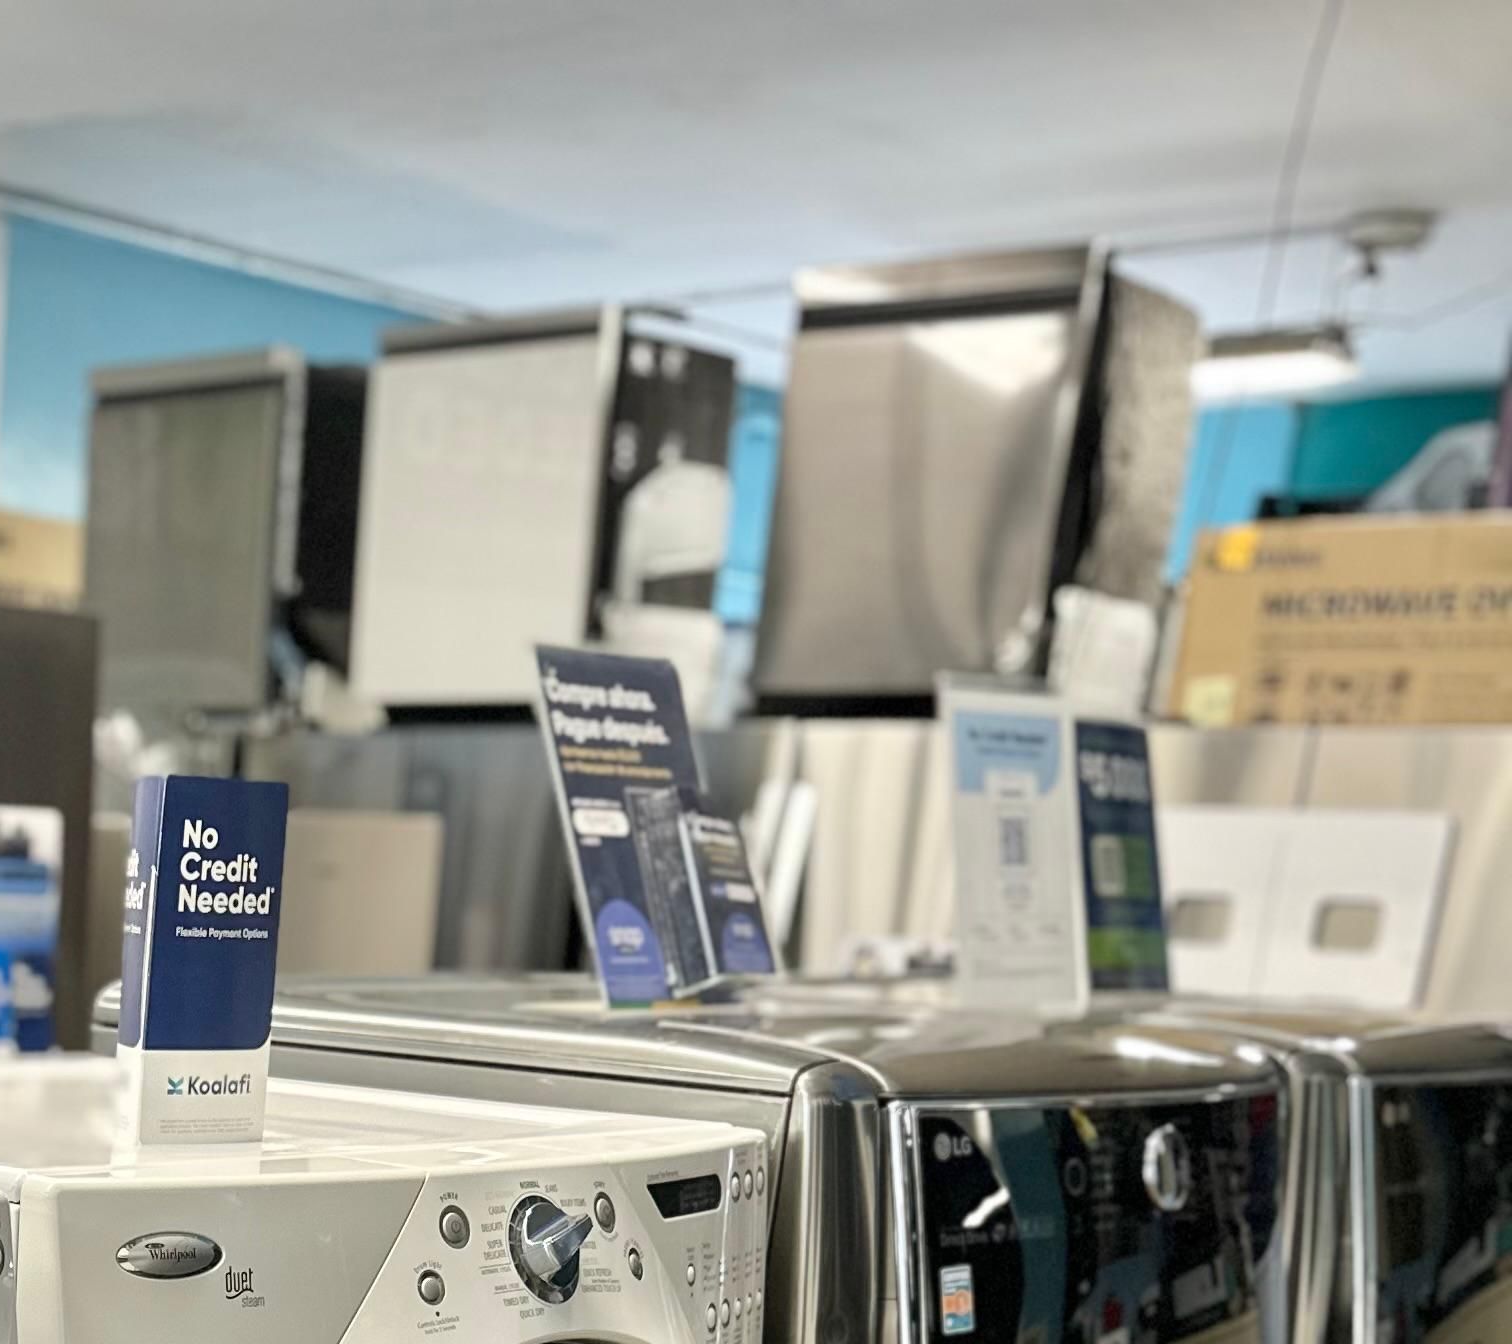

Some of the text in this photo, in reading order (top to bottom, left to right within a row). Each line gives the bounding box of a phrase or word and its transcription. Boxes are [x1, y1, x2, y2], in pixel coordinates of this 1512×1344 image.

[182, 819, 219, 849] No
[180, 851, 258, 883] Credit
[175, 926, 269, 940] Flexible Payment Options
[188, 1074, 251, 1095] Koalafi
[952, 1137, 973, 1155] LG
[149, 1247, 196, 1261] Whirlpool
[225, 1266, 254, 1293] duet
[242, 1296, 265, 1308] steam
